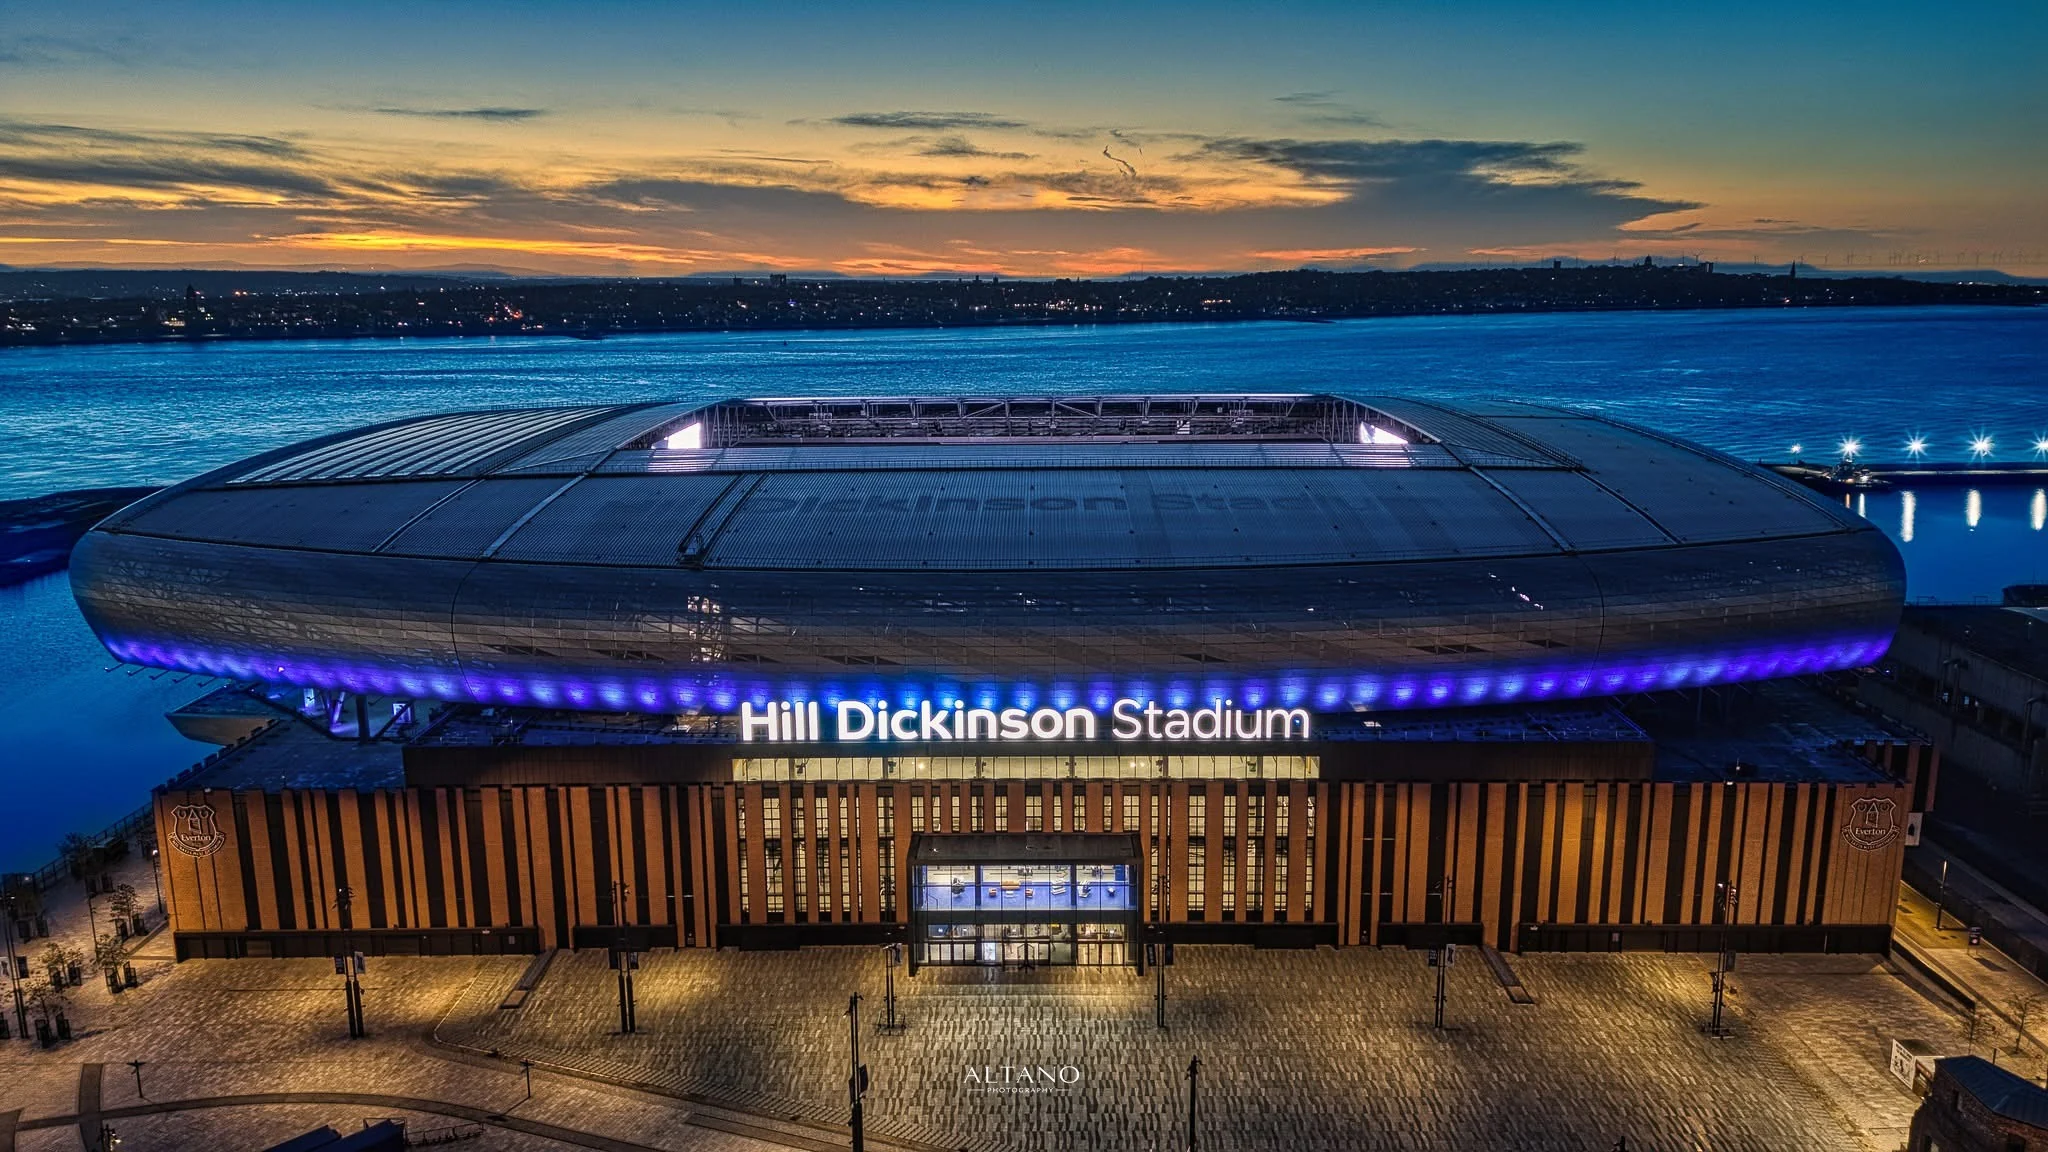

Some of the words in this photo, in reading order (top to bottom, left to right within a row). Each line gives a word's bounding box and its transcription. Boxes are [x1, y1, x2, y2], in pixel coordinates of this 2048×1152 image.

[741, 700, 819, 741] Hill
[837, 698, 1095, 741] Dickinson
[1112, 697, 1310, 741] Stadium
[1855, 827, 1886, 835] Everton
